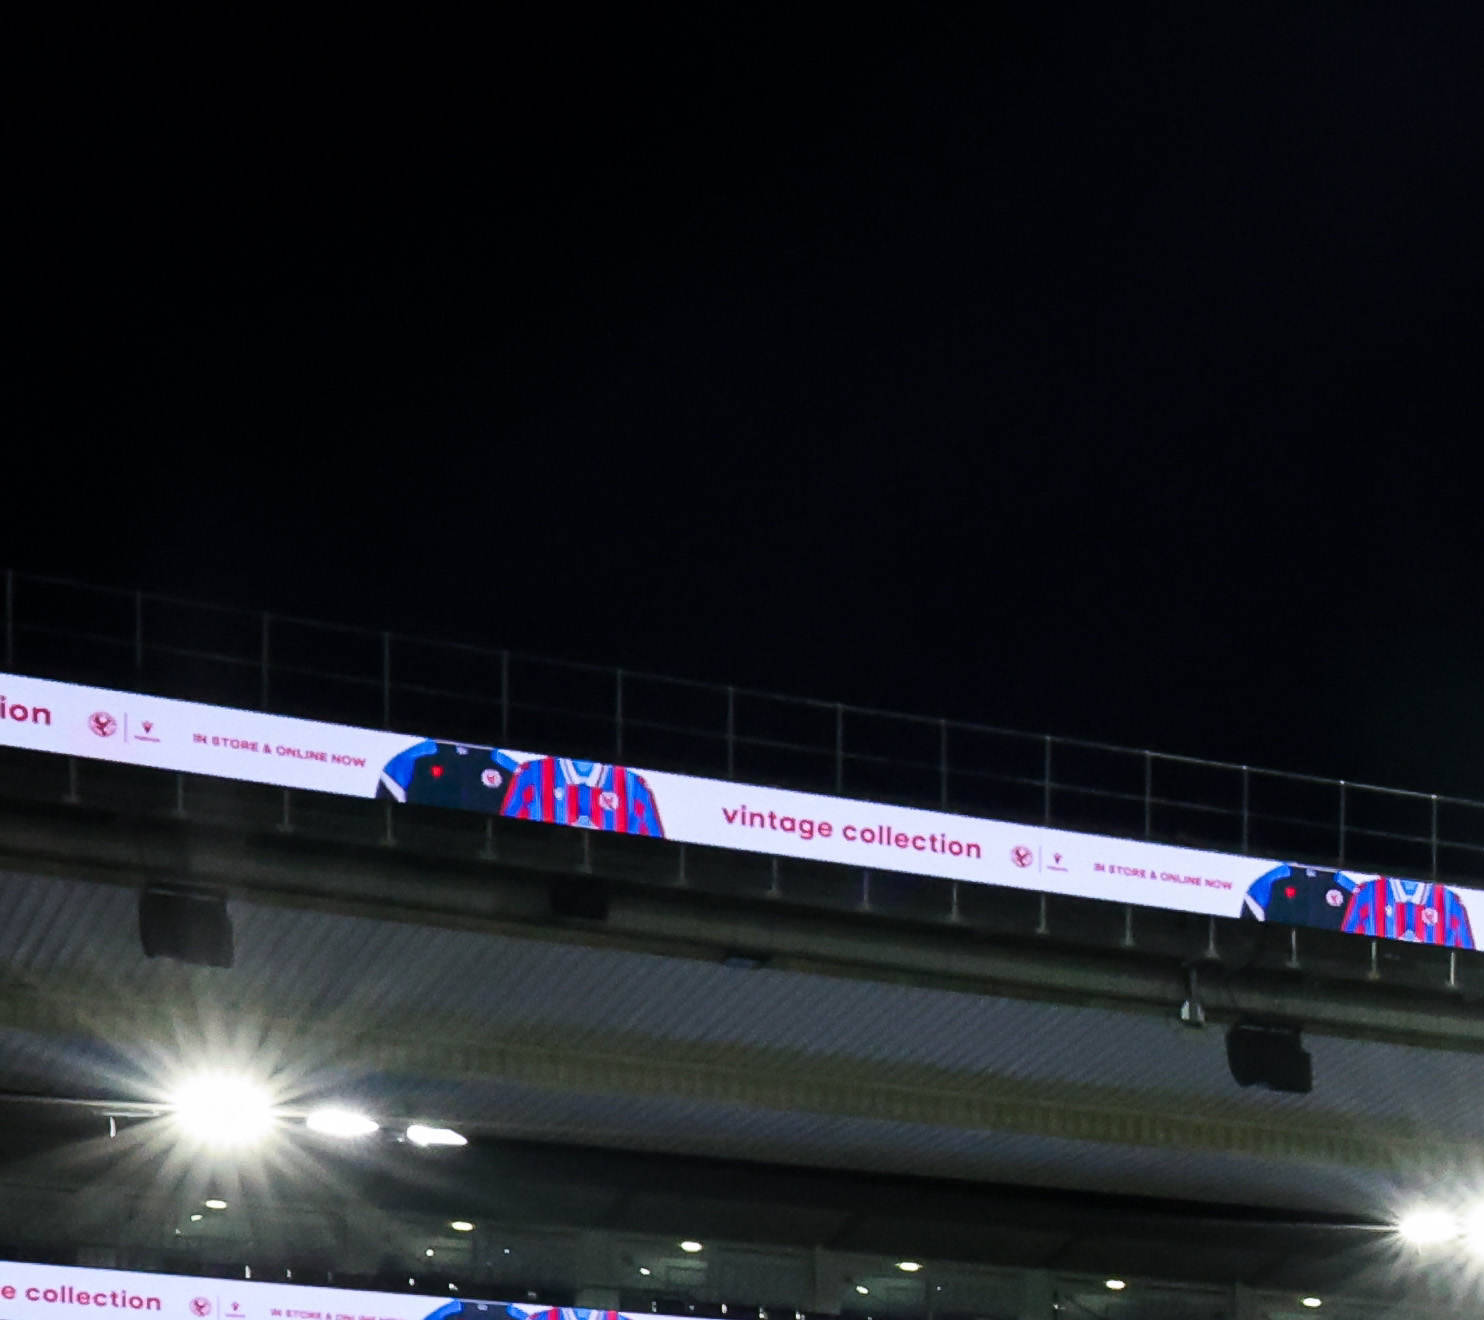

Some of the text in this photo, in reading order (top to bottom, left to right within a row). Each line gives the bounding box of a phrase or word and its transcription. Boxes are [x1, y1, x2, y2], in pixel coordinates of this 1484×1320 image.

[211, 735, 259, 752] STORE
[275, 744, 328, 762] ONLINE
[330, 753, 366, 768] NOW
[720, 803, 981, 859] vintage collection
[24, 1284, 161, 1310] collection
